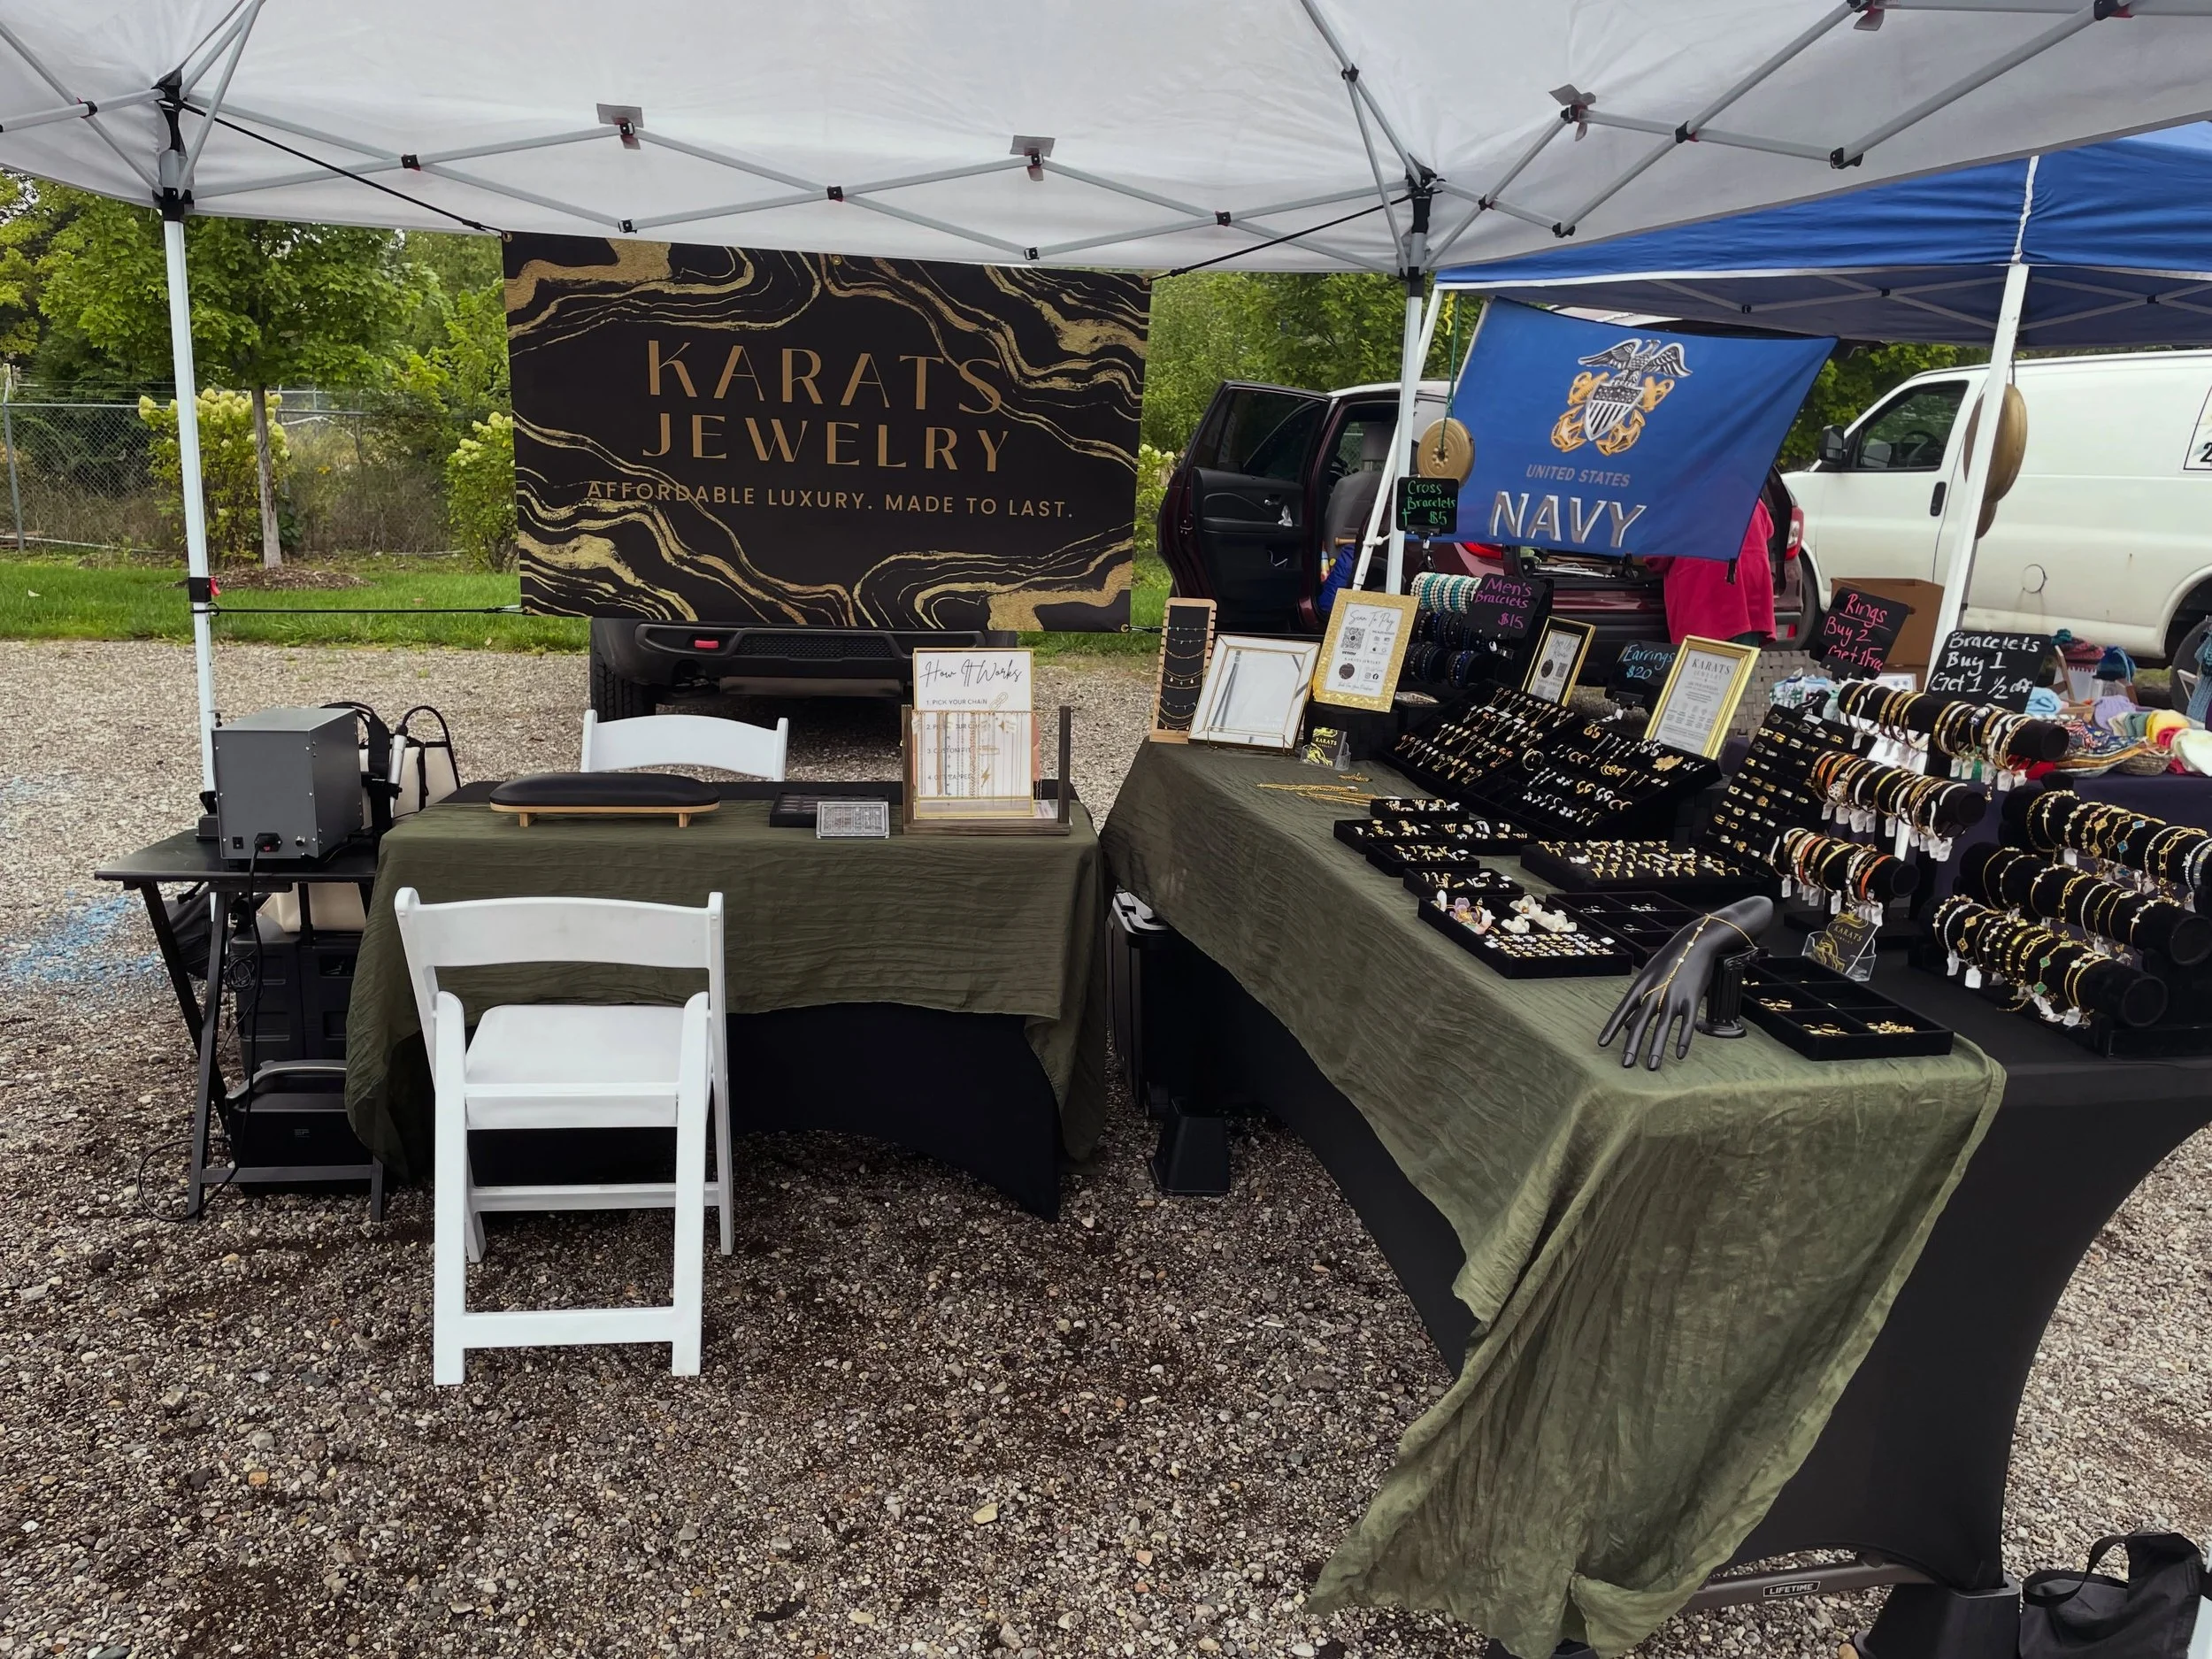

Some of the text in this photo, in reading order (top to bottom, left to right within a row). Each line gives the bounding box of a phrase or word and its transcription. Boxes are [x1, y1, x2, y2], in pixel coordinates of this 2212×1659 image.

[648, 340, 1002, 414] KARATS
[642, 413, 1009, 472] JEWELRY
[1526, 464, 1631, 488] UNITED STATES
[1408, 480, 1442, 495] Cross
[588, 480, 1074, 518] AFFORDABLE LUXURY. MADE TO LAST.
[1407, 496, 1456, 511] Bracelets
[1429, 511, 1448, 526] $5
[1489, 491, 1647, 549] NAVY
[1486, 577, 1532, 597] Men's
[1498, 612, 1524, 629] $15
[1845, 593, 1888, 628] Rings
[1379, 611, 1395, 632] Pay
[1824, 616, 1872, 648] Buy 2
[1948, 632, 2040, 652] Bracelets
[1623, 644, 1676, 671] Earrings
[1828, 645, 1858, 663] Get
[1946, 651, 2007, 677] Buy 1
[919, 658, 1023, 687] How It Works
[1626, 664, 1653, 680] $20
[1692, 658, 1732, 674] KARATS
[1930, 672, 1966, 692] Get
[1966, 675, 1983, 693] 1
[1315, 737, 1338, 746] KARATS
[1834, 926, 1863, 942] KARATS
[1769, 1583, 1814, 1595] LIFETIME
